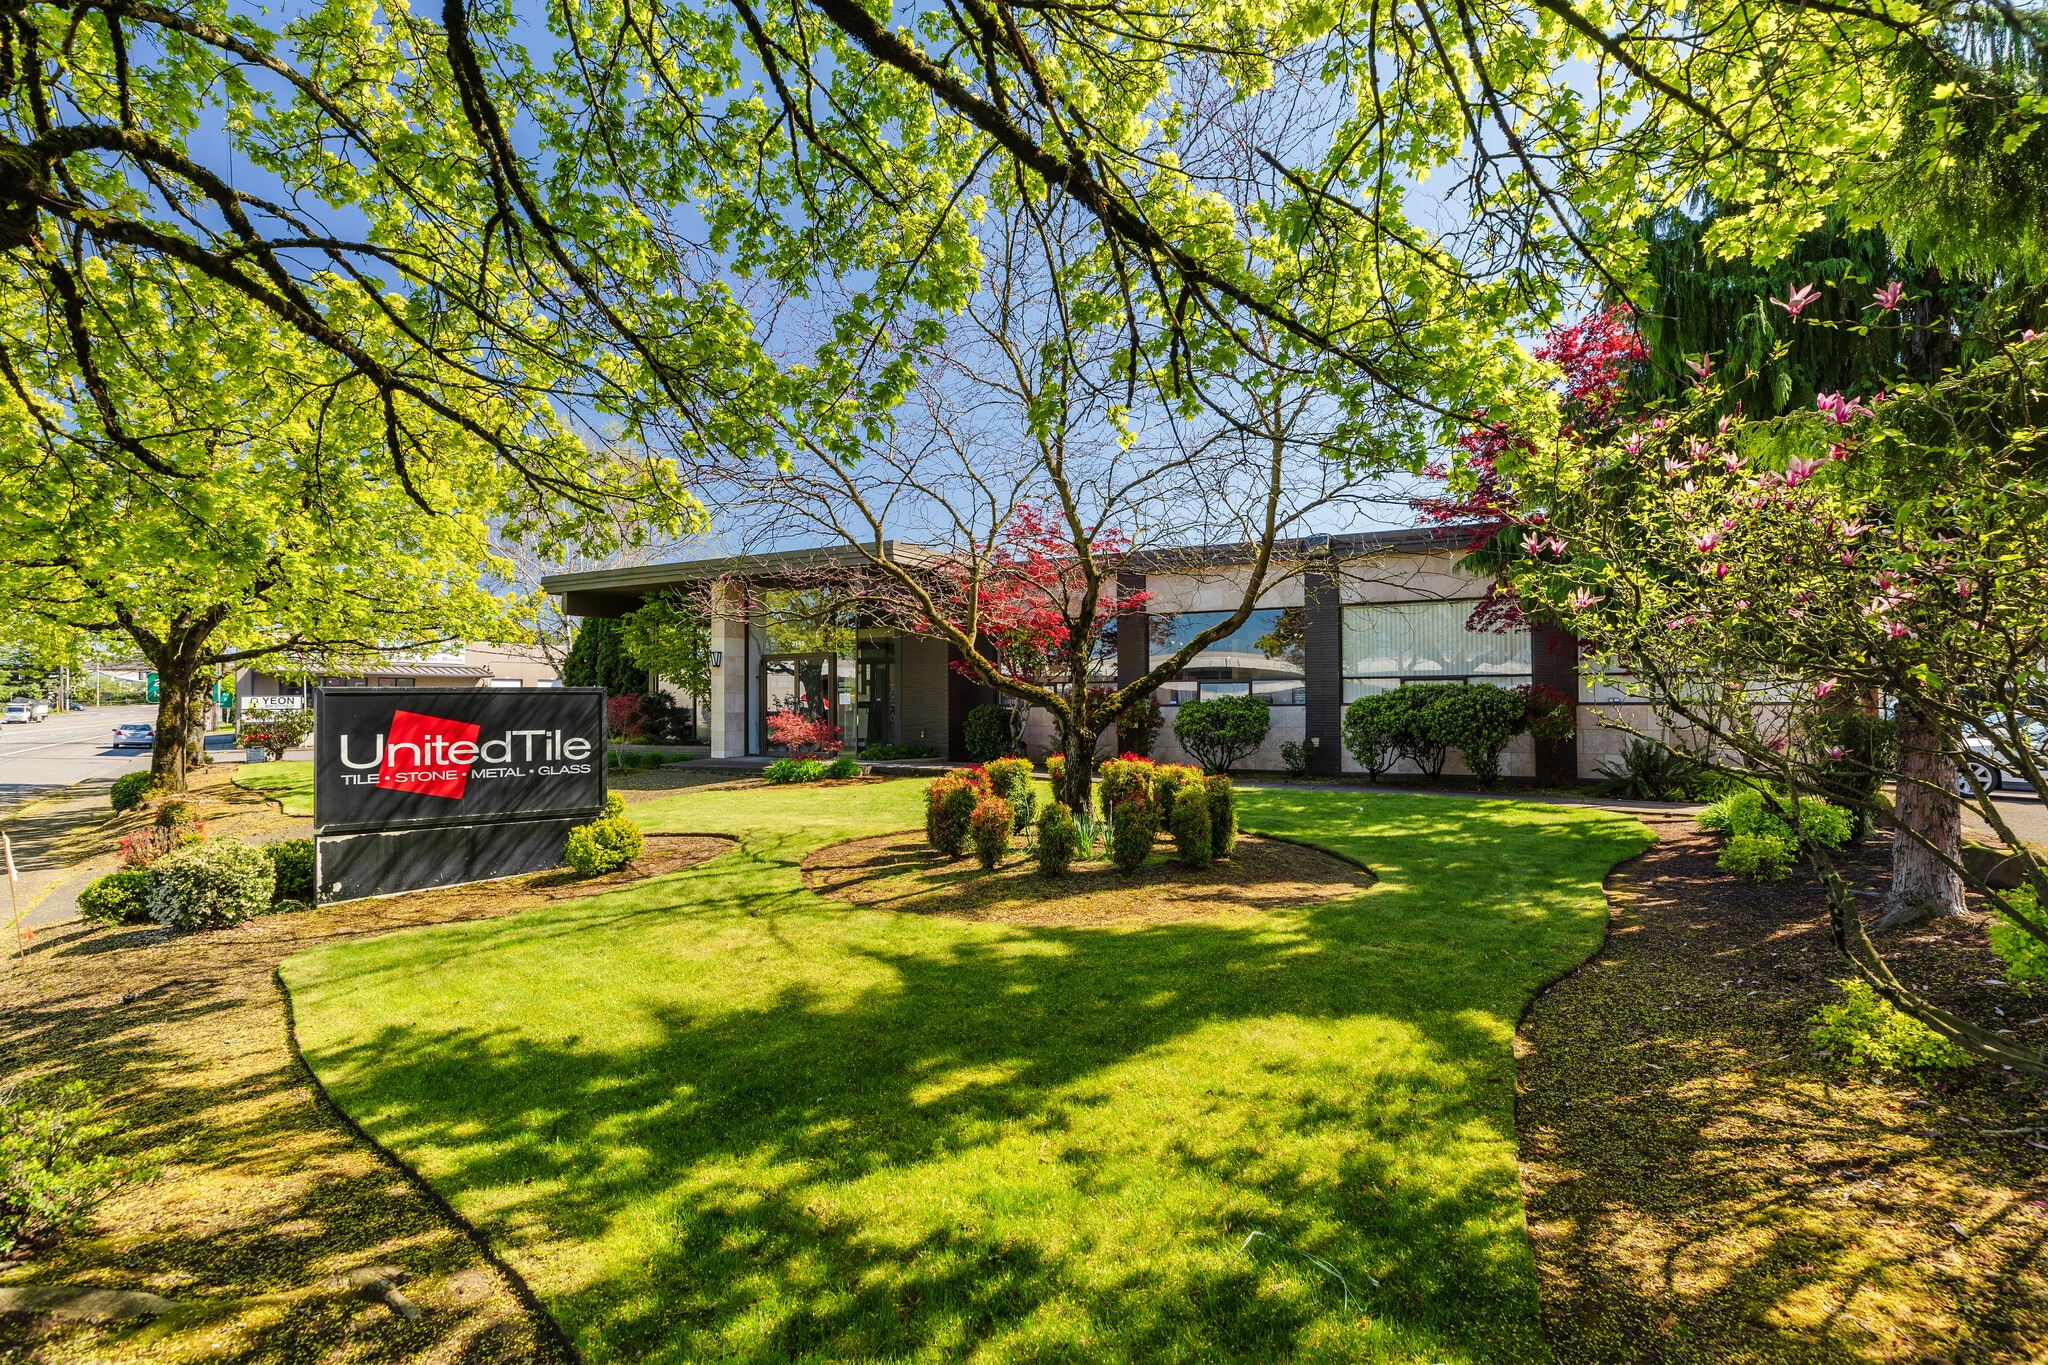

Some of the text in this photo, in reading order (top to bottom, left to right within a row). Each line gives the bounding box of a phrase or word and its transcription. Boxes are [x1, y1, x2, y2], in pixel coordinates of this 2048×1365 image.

[340, 730, 591, 769] UnitedTile
[341, 764, 592, 786] TILE STONE METAL GLASS
